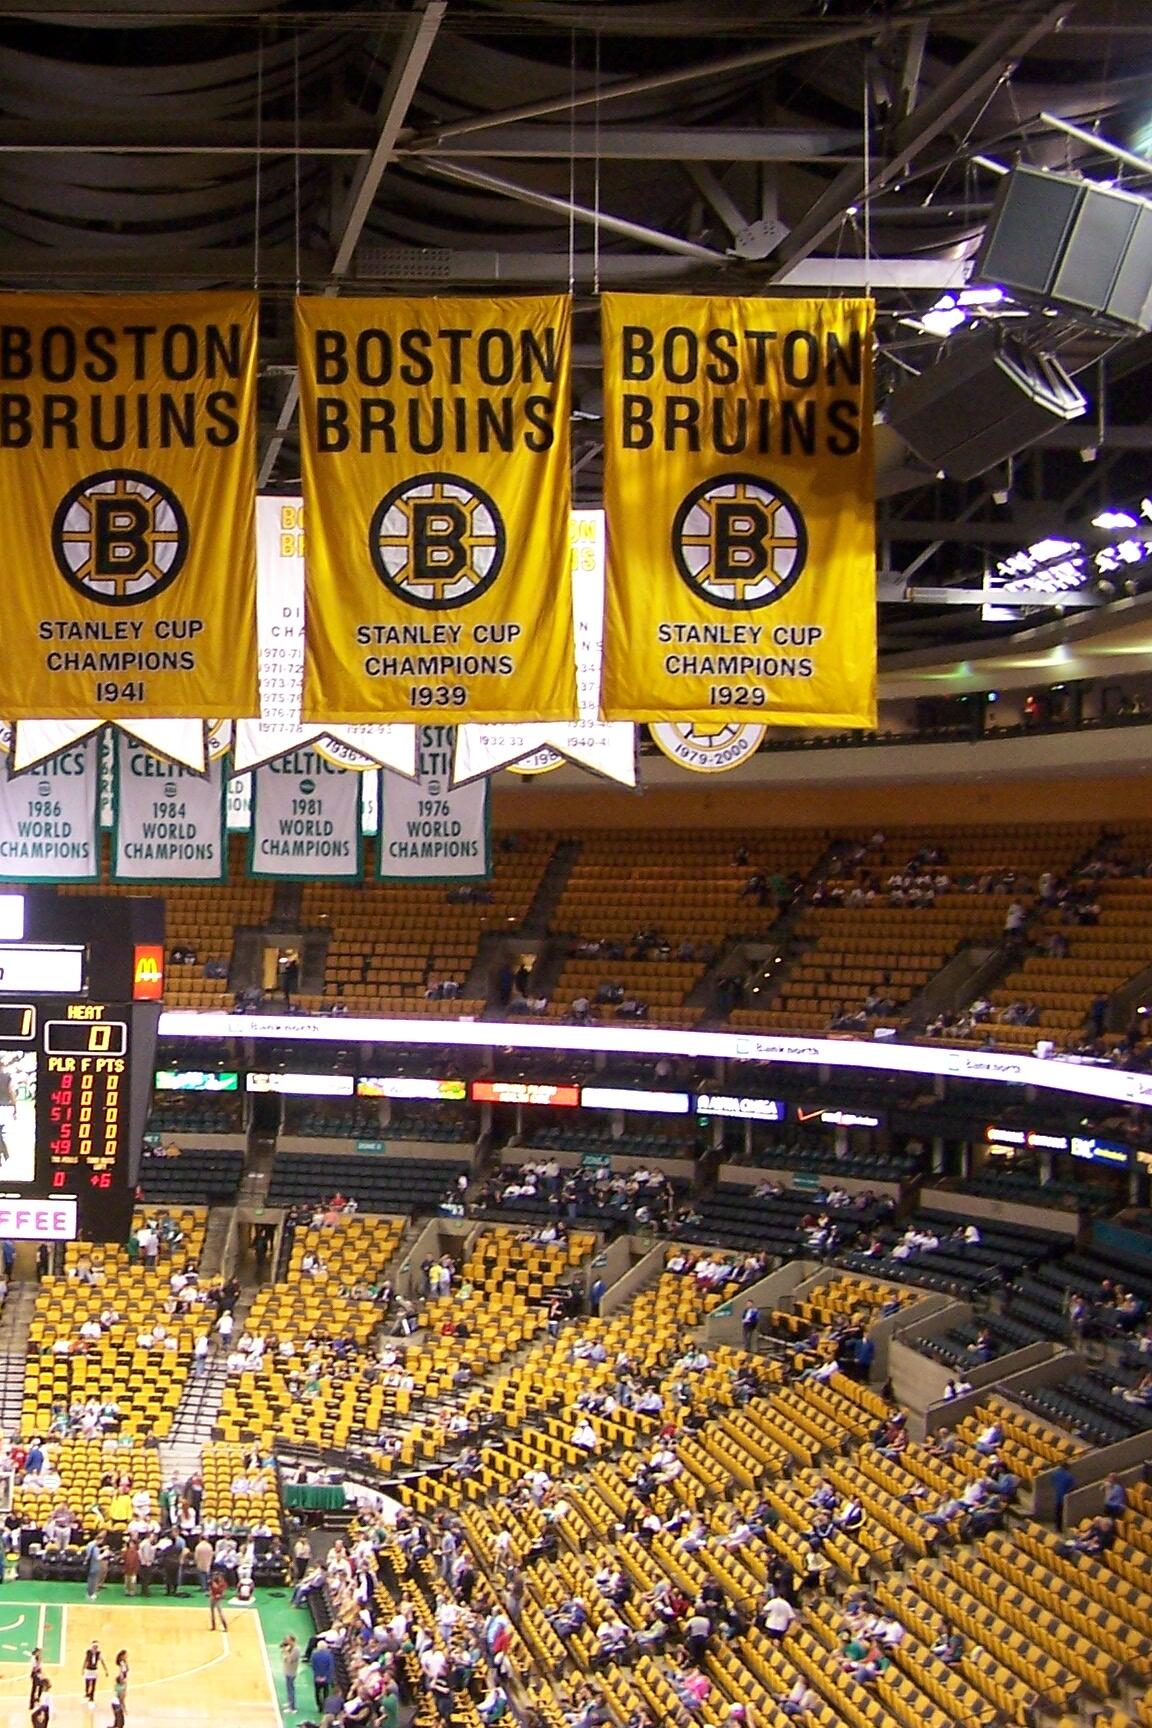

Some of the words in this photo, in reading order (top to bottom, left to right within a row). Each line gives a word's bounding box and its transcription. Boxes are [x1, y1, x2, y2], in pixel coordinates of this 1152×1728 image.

[0, 323, 242, 384] BOSTON
[315, 327, 555, 387] BOSTON
[622, 325, 861, 388] BOSTON
[0, 391, 239, 452] BRUINS
[316, 394, 555, 454] BRUINS
[622, 393, 860, 456] BRUINS
[38, 620, 144, 641] STANLEY
[154, 619, 204, 640] CUP
[356, 623, 460, 645] STANLEY
[472, 622, 522, 645] CUP
[658, 622, 762, 645] STANLEY
[772, 624, 823, 646] CUP
[46, 650, 196, 672] CHAMPIONS
[363, 654, 514, 677] CHAMPIONS
[665, 654, 814, 678] CHAMPIONS
[95, 682, 145, 702] 1941
[409, 686, 467, 707] 1939
[708, 686, 766, 708] 1929
[674, 739, 748, 765] 1979-2000
[27, 800, 62, 818] 1986
[152, 802, 187, 819] 1984
[291, 799, 323, 816] 1981
[417, 800, 451, 816] 1976
[17, 821, 72, 838] WORLD
[142, 823, 197, 839] WORLD
[278, 819, 334, 836] WORLD
[406, 821, 462, 837] WORLD
[0, 841, 90, 859] CHAMPIONS
[124, 843, 214, 860] CHAMPIONS
[261, 839, 350, 857] CHAMPIONS
[389, 840, 479, 857] CHAMPIONS
[67, 1005, 105, 1020] HEAT
[21, 1009, 33, 1036] 1
[88, 1025, 111, 1051] 0
[48, 1057, 76, 1072] PLR
[81, 1058, 92, 1072] F
[96, 1058, 125, 1072] PTS
[61, 1074, 73, 1089] 8
[81, 1074, 94, 1089] 0
[106, 1075, 119, 1090] 0
[51, 1091, 72, 1105] 40
[80, 1091, 93, 1106] 0
[106, 1091, 119, 1106] 0
[51, 1107, 72, 1121] 51
[79, 1107, 92, 1122] 0
[105, 1107, 118, 1122] 0
[60, 1123, 72, 1138] 5
[78, 1123, 91, 1138] 0
[105, 1124, 118, 1139] 0
[51, 1140, 72, 1154] 49
[79, 1140, 92, 1155] 0
[104, 1140, 117, 1155] 0
[53, 1172, 66, 1187] 0
